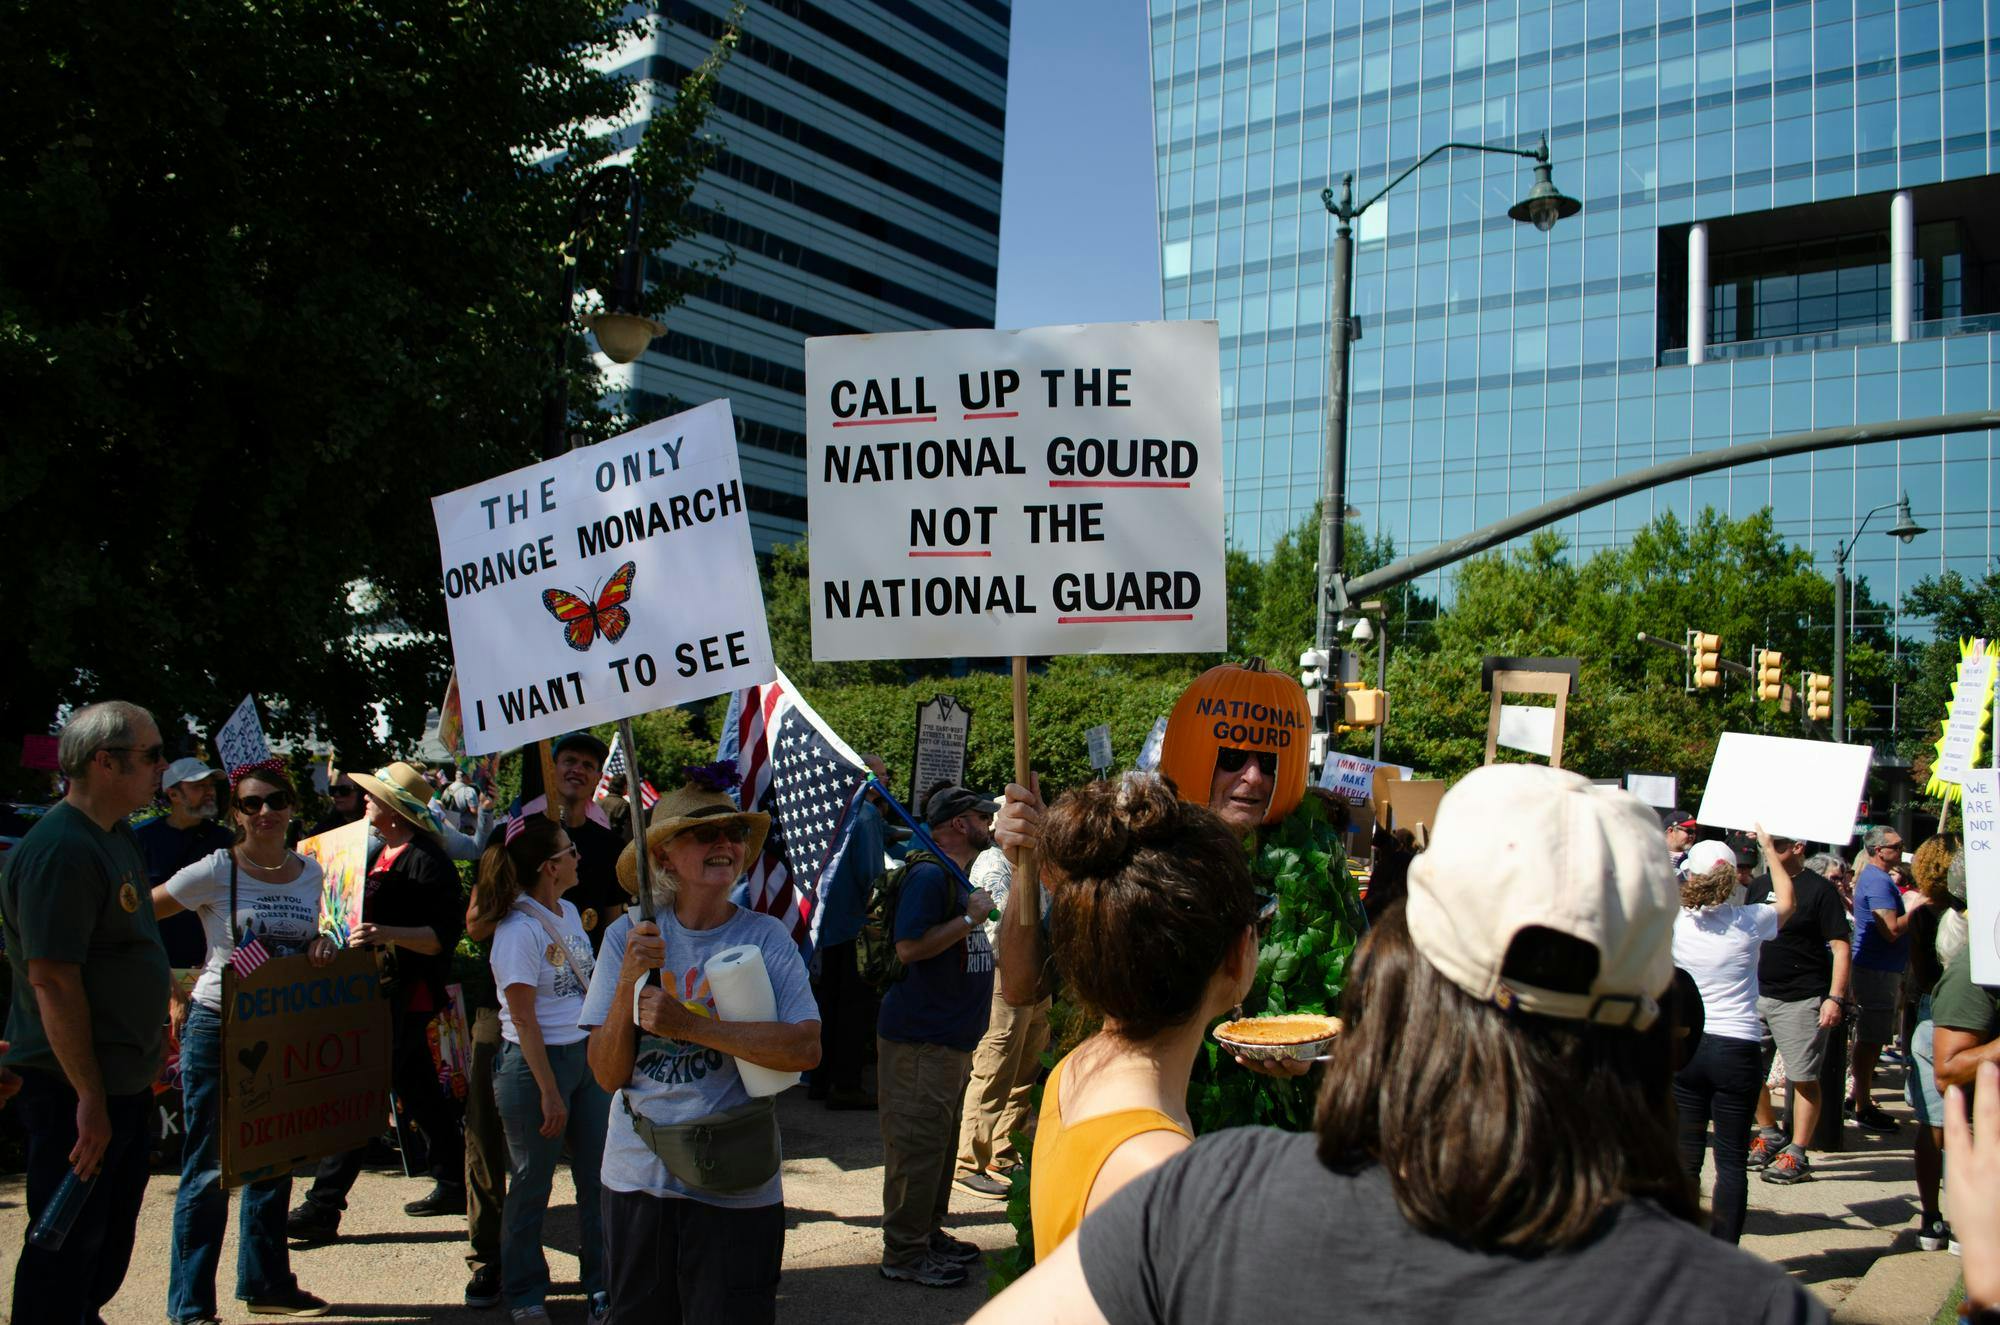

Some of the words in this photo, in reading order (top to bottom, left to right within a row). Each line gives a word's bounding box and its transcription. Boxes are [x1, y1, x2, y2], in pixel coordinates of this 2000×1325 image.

[830, 376, 937, 418] CALL
[959, 369, 1020, 410] UP
[1041, 368, 1132, 408] THE
[824, 436, 1026, 484] NATIONAL
[1047, 437, 1198, 478] GOURD
[481, 477, 557, 530] THE
[596, 436, 683, 492] ONLY
[445, 535, 557, 599] ORANGE
[577, 479, 742, 559] MONARCH
[910, 506, 997, 547] NOT
[1023, 502, 1104, 544] THE
[824, 574, 1036, 619] NATIONAL
[1053, 571, 1201, 613] GUARD
[476, 700, 486, 731] I
[498, 672, 585, 725] WANT
[609, 653, 657, 693] TO
[675, 630, 750, 678] SEE
[1196, 697, 1305, 729] NATIONAL
[1213, 721, 1291, 748] GOURD
[1332, 785, 1370, 799] AMERICA
[1341, 773, 1366, 786] MAKE
[1966, 781, 1989, 794] WE
[1966, 800, 1993, 813] ARE
[1970, 820, 1994, 832] NOT
[1970, 839, 1991, 851] OK
[273, 904, 312, 913] PREVENT
[283, 895, 302, 904] YOU
[238, 972, 379, 1021] DEMOCRACY
[283, 1028, 369, 1079] NOT
[636, 1047, 723, 1084] MEXICO
